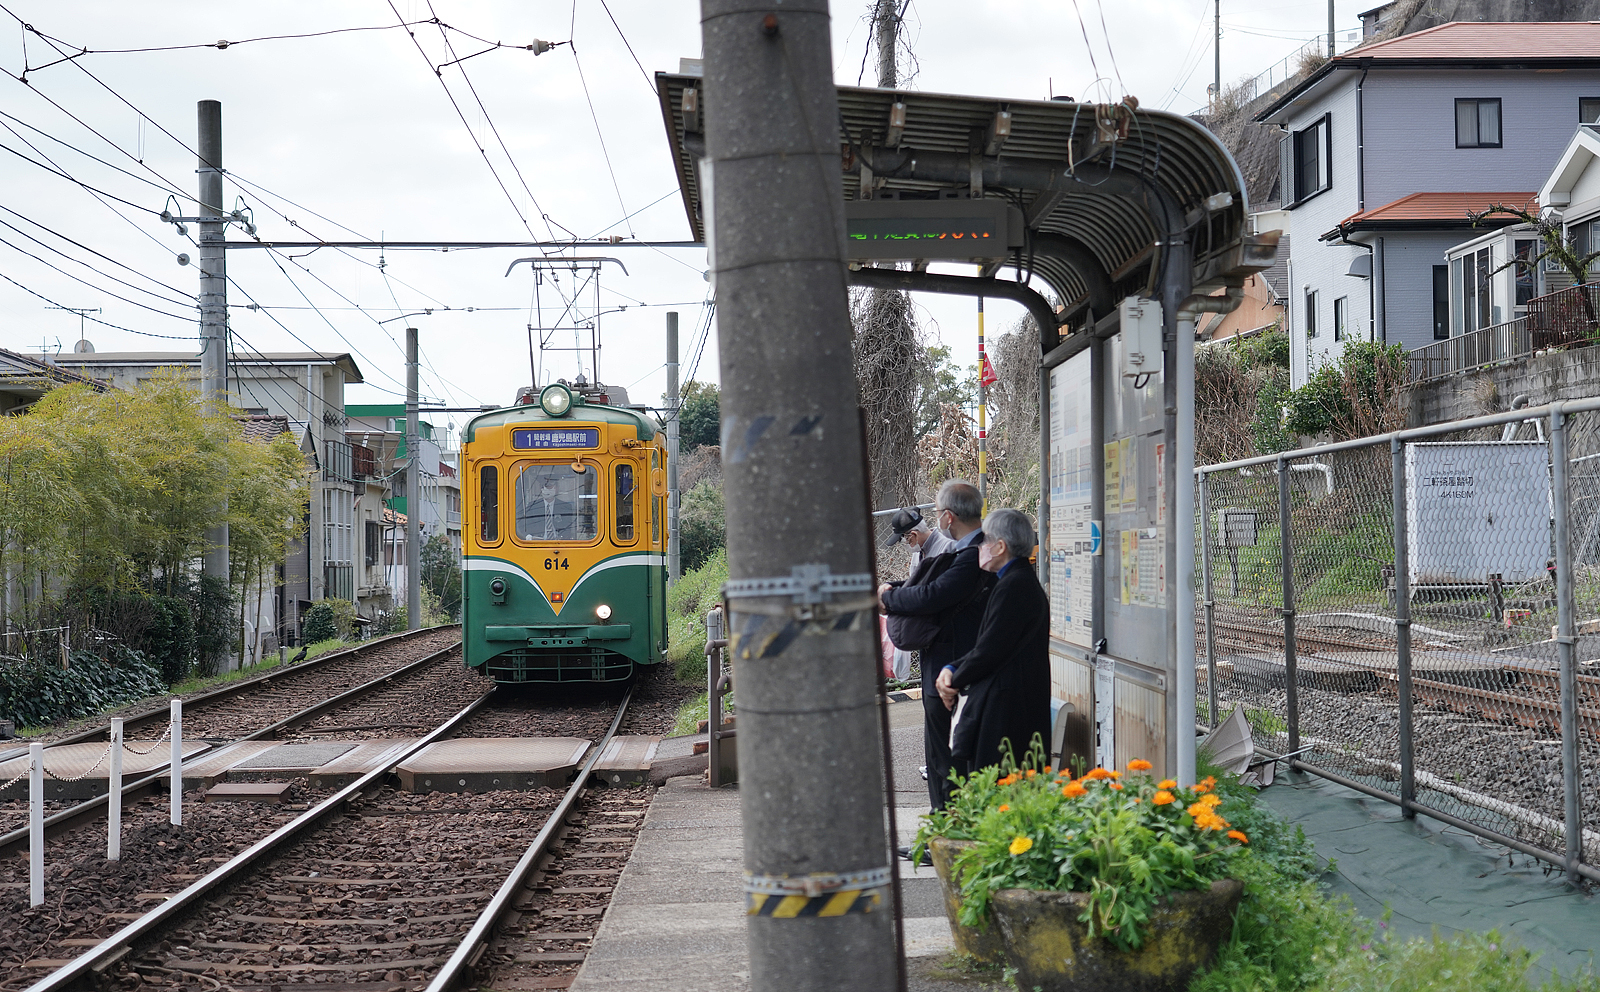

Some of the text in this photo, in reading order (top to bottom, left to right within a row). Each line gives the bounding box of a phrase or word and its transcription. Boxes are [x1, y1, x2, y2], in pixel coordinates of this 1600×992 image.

[526, 433, 532, 447] 1
[551, 432, 587, 443] 鹿児島駅前
[1423, 476, 1474, 487] 二軒茶屋踏切
[544, 558, 570, 570] 614
